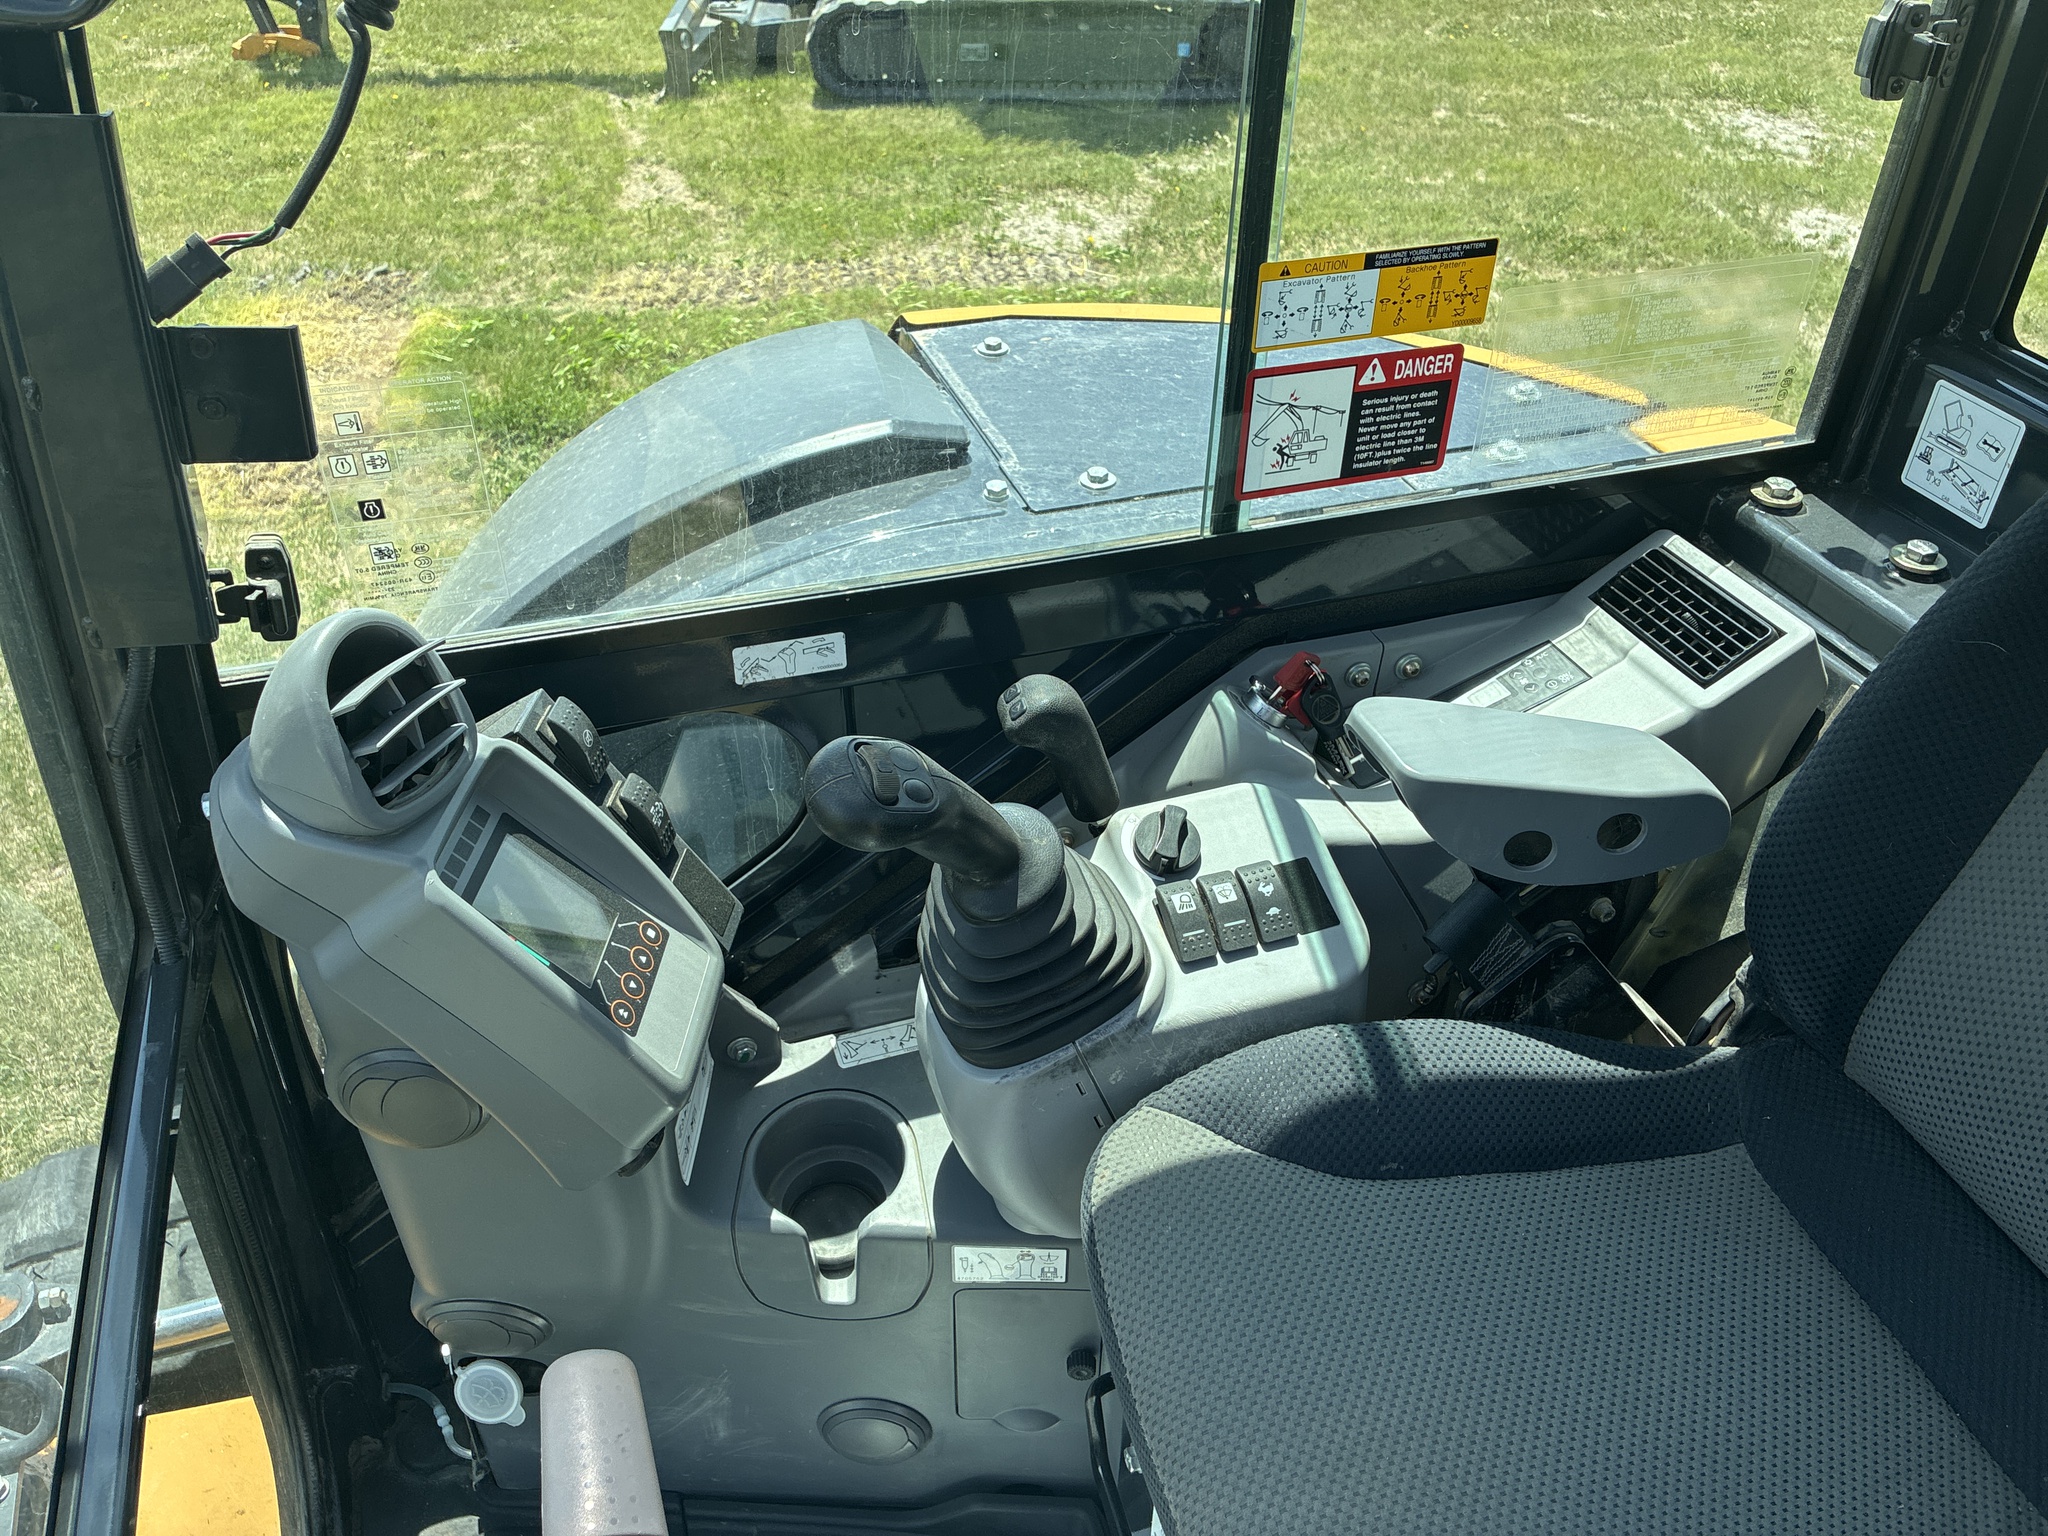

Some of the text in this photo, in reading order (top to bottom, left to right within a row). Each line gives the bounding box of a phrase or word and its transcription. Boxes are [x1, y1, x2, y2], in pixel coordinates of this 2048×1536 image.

[1374, 258, 1402, 267] SELECTED
[1411, 254, 1441, 263] OPERATING
[1376, 250, 1408, 260] FAMILIARIZE
[1408, 248, 1436, 256] YOURSELF
[1304, 259, 1349, 274] CAUTION
[1406, 261, 1466, 273] Backhoe Pattern
[1282, 274, 1356, 288] Excavator Pattern
[1394, 353, 1454, 380] DANGER
[426, 375, 452, 383] ACTION
[1362, 398, 1388, 406] Serious
[1390, 394, 1409, 402] injury
[1419, 390, 1438, 398] death
[436, 405, 460, 413] operated
[1375, 405, 1394, 413] result
[1413, 399, 1438, 408] contact
[1360, 410, 1421, 424] with electric lines.
[1358, 425, 1378, 433] Never
[1413, 418, 1427, 426] part
[1381, 431, 1395, 439] load
[1397, 428, 1418, 436] closer
[1355, 442, 1381, 451] electric
[1393, 446, 1411, 454] twice
[1353, 456, 1405, 469] insulator length.
[1535, 651, 1549, 660] A/C
